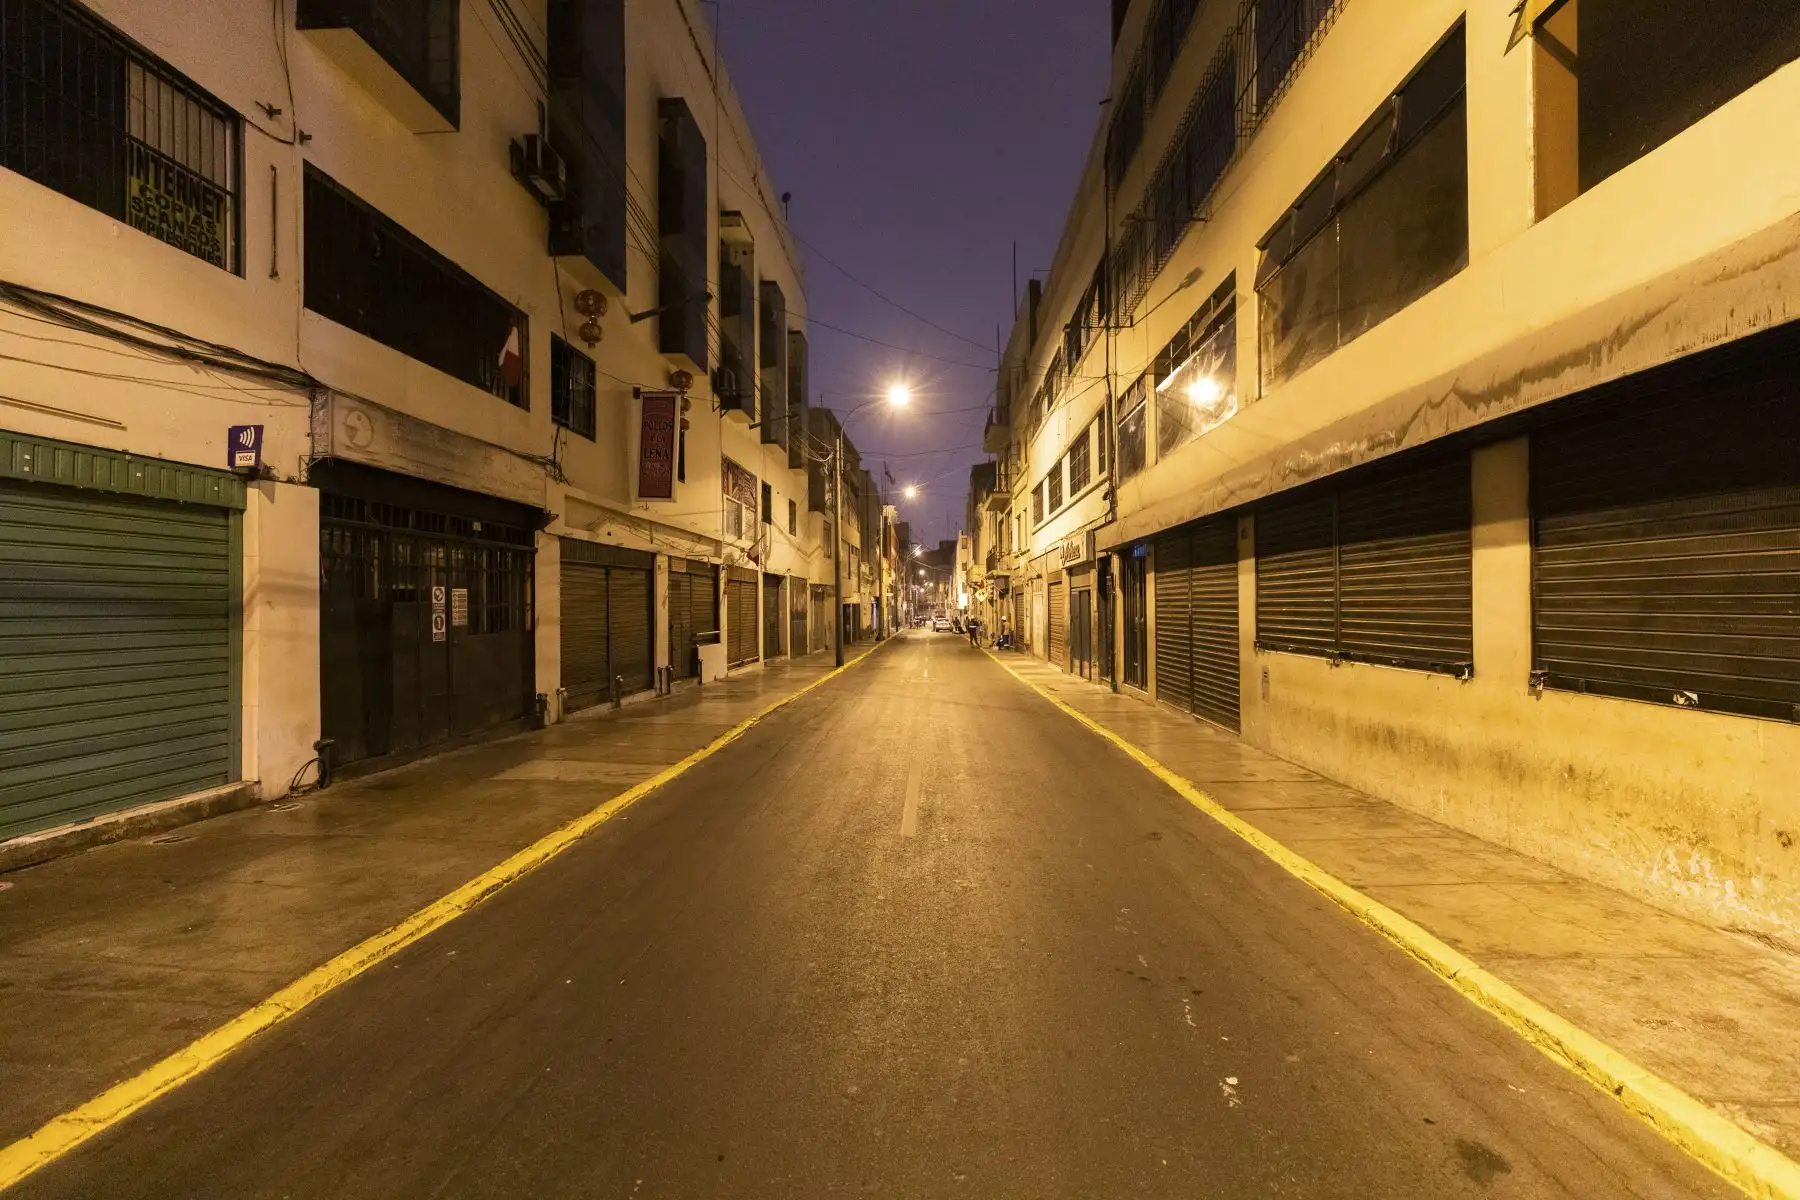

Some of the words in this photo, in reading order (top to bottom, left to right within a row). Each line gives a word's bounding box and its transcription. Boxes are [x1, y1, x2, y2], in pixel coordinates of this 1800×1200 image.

[127, 141, 224, 223] INTERNET
[131, 196, 221, 253] SCANEOS
[139, 185, 216, 235] COPIAS
[644, 420, 672, 431] POLLOS
[239, 454, 252, 462] VISA
[643, 445, 670, 460] LEÑA
